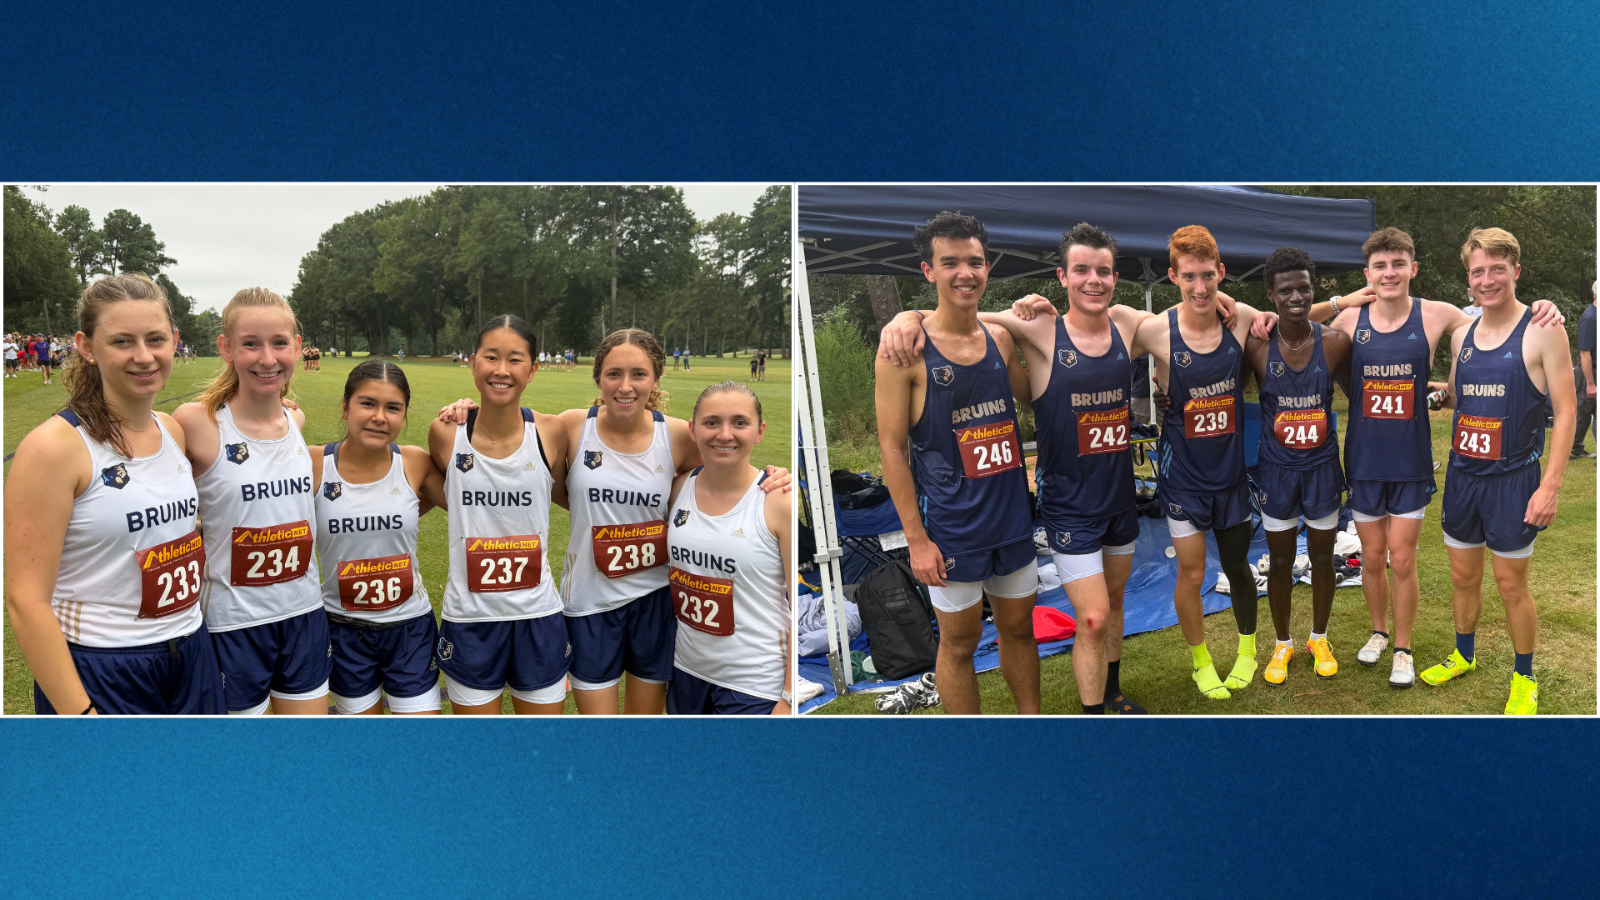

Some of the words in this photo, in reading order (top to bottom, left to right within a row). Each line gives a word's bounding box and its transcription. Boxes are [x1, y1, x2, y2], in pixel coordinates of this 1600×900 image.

[1363, 364, 1412, 377] BRUINS
[1070, 388, 1124, 406] BRUINS
[1189, 378, 1236, 399] BRUINS
[1462, 384, 1506, 397] BRUINS
[952, 398, 1006, 424] BRUINS
[1278, 394, 1322, 408] BRUINS
[1371, 395, 1404, 414] 241
[1194, 411, 1228, 432] 239
[1089, 424, 1128, 448] 242
[1283, 425, 1318, 444] 244
[1460, 431, 1490, 454] 243
[973, 440, 1012, 470] 246
[241, 476, 310, 502] BRUINS
[462, 490, 532, 507] BRUINS
[588, 488, 661, 508] BRUINS
[126, 497, 196, 532] BRUINS
[328, 514, 404, 534] BRUINS
[247, 546, 300, 578] 234
[607, 542, 656, 571] 238
[670, 546, 736, 574] BRUINS
[480, 557, 528, 584] 237
[157, 560, 201, 608] 233
[352, 577, 402, 604] 236
[678, 591, 720, 628] 232
